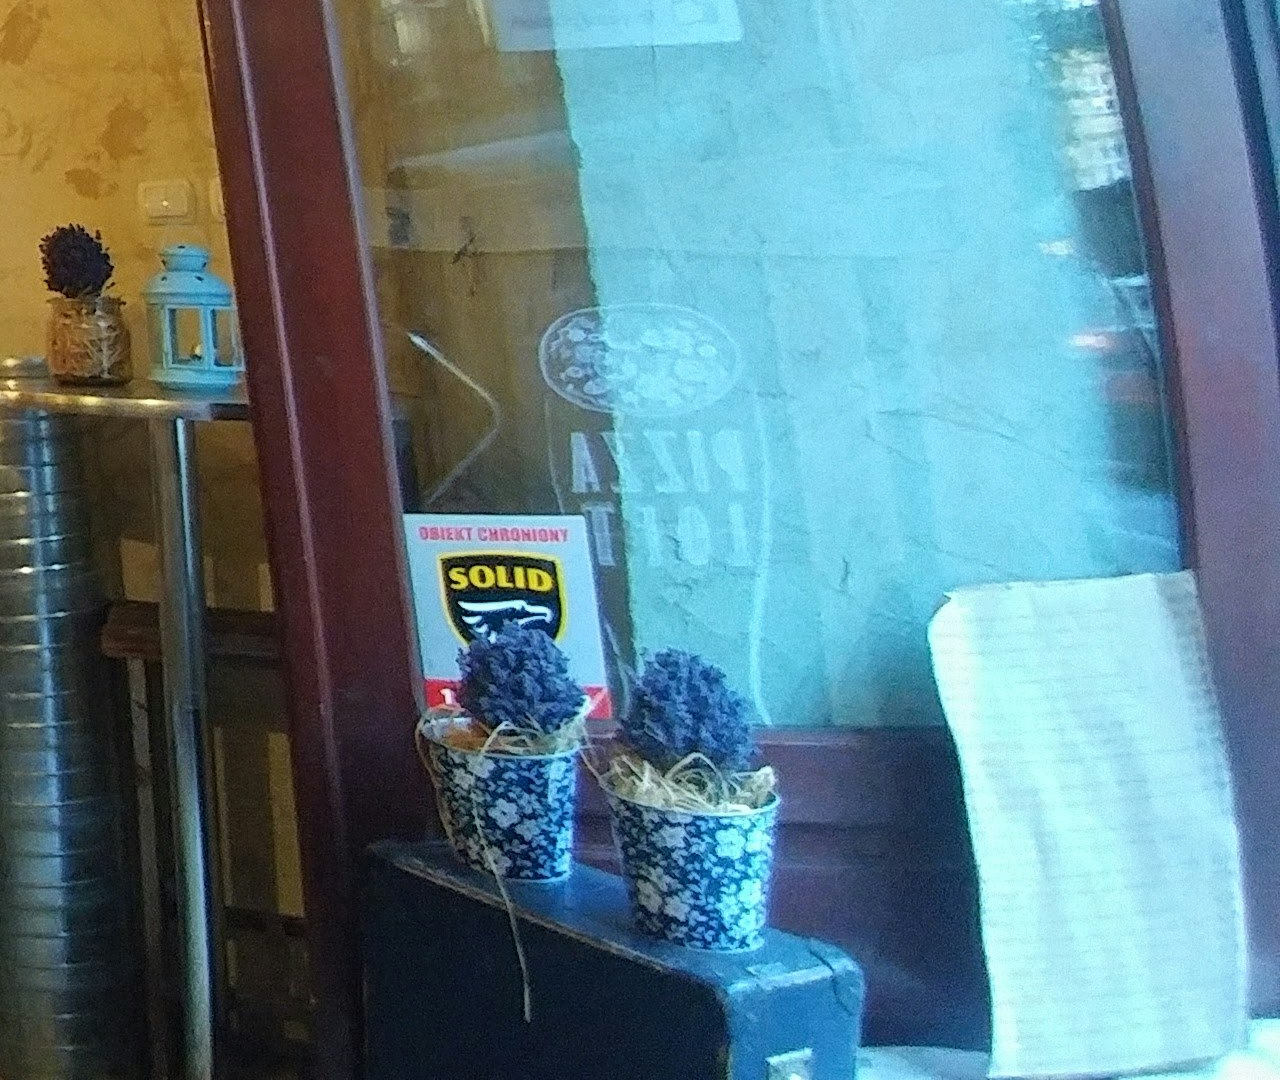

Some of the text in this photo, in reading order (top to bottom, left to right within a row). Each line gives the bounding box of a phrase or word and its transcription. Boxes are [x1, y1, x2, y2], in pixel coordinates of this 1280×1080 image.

[418, 526, 569, 543] OBIEKT CHRONIONY
[448, 565, 553, 593] SOLID
